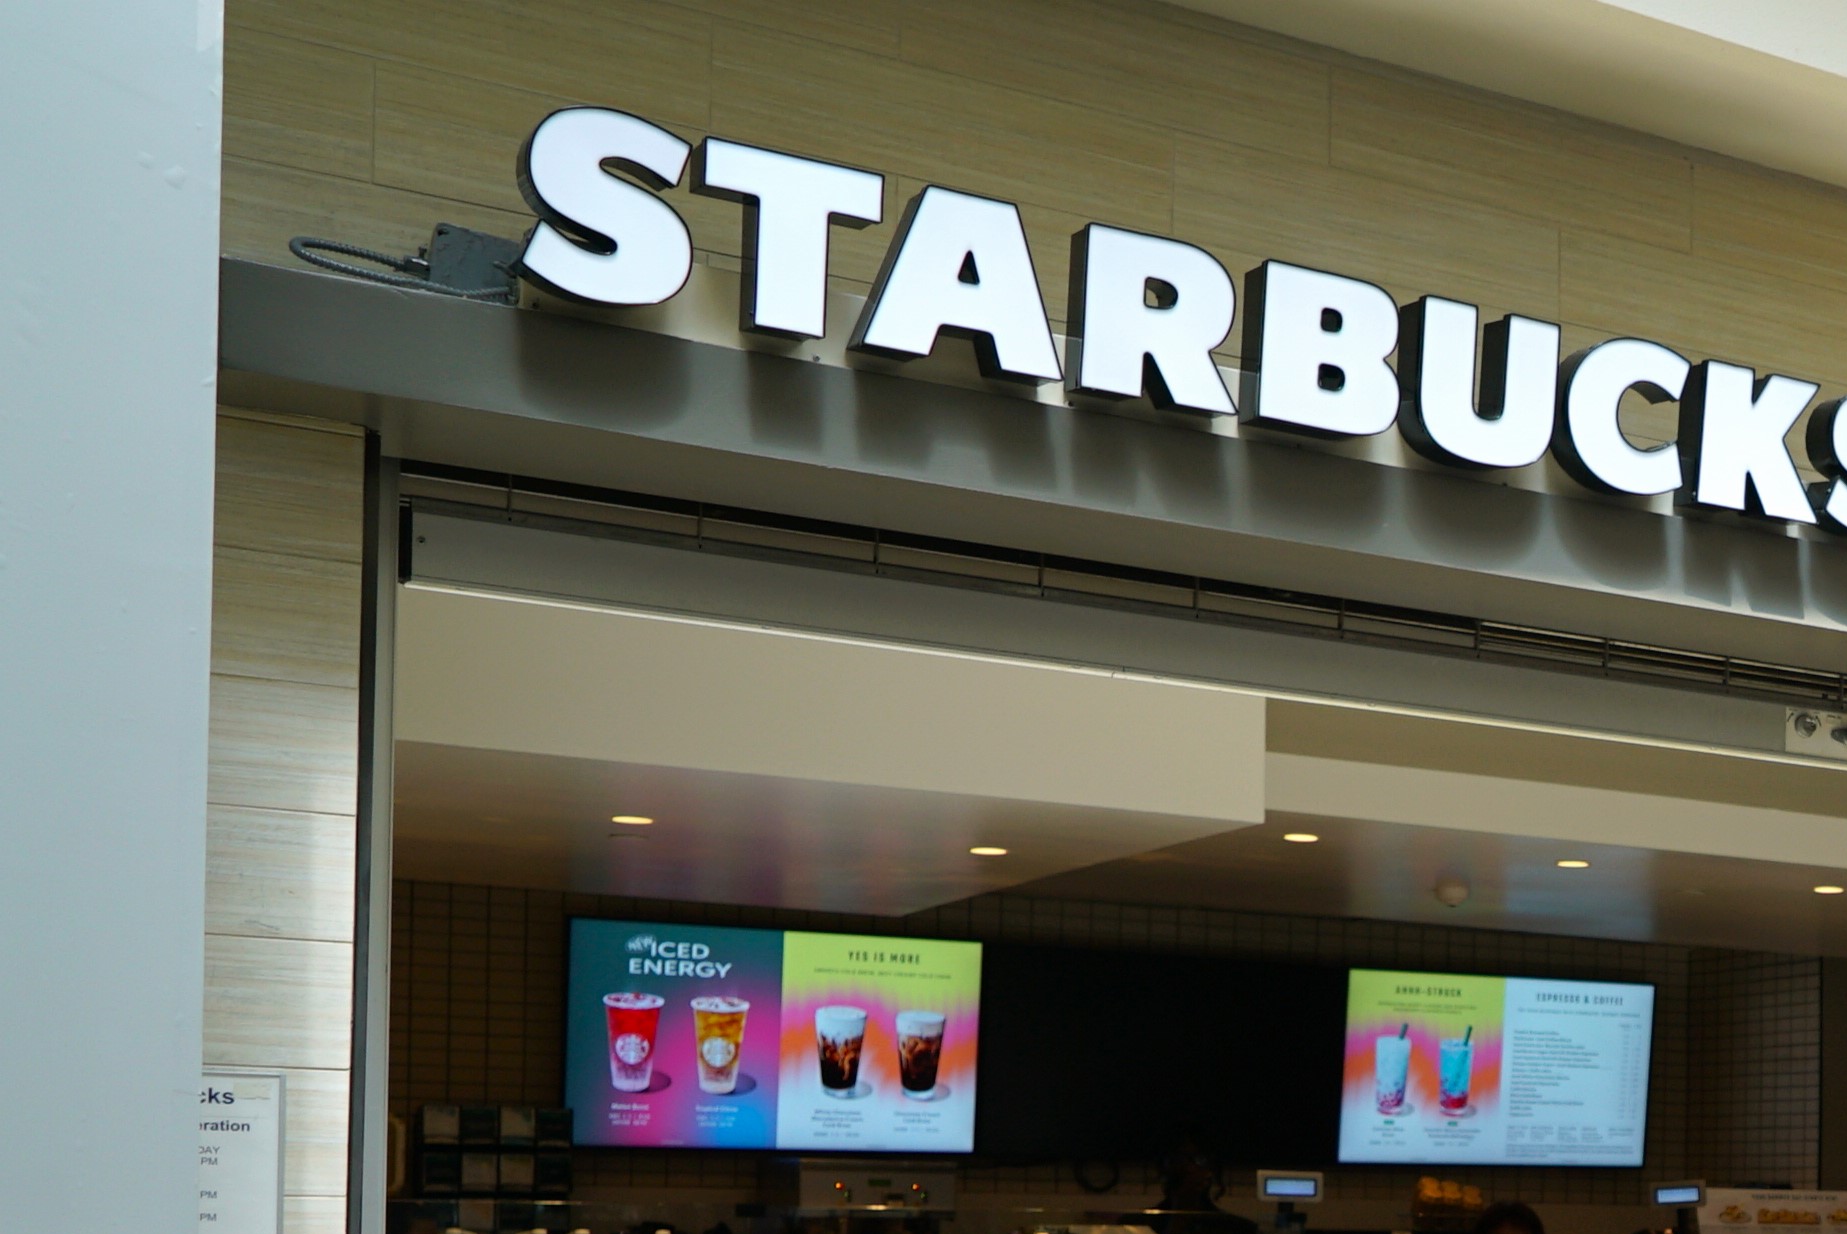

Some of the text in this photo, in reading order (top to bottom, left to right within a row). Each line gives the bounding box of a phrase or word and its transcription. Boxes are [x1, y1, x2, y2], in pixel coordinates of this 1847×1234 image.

[650, 941, 710, 960] ICED
[628, 957, 733, 979] ENERGY
[199, 1120, 250, 1132] ration
[200, 1157, 218, 1166] PM
[200, 1190, 218, 1199] PM
[199, 1213, 217, 1222] PM
